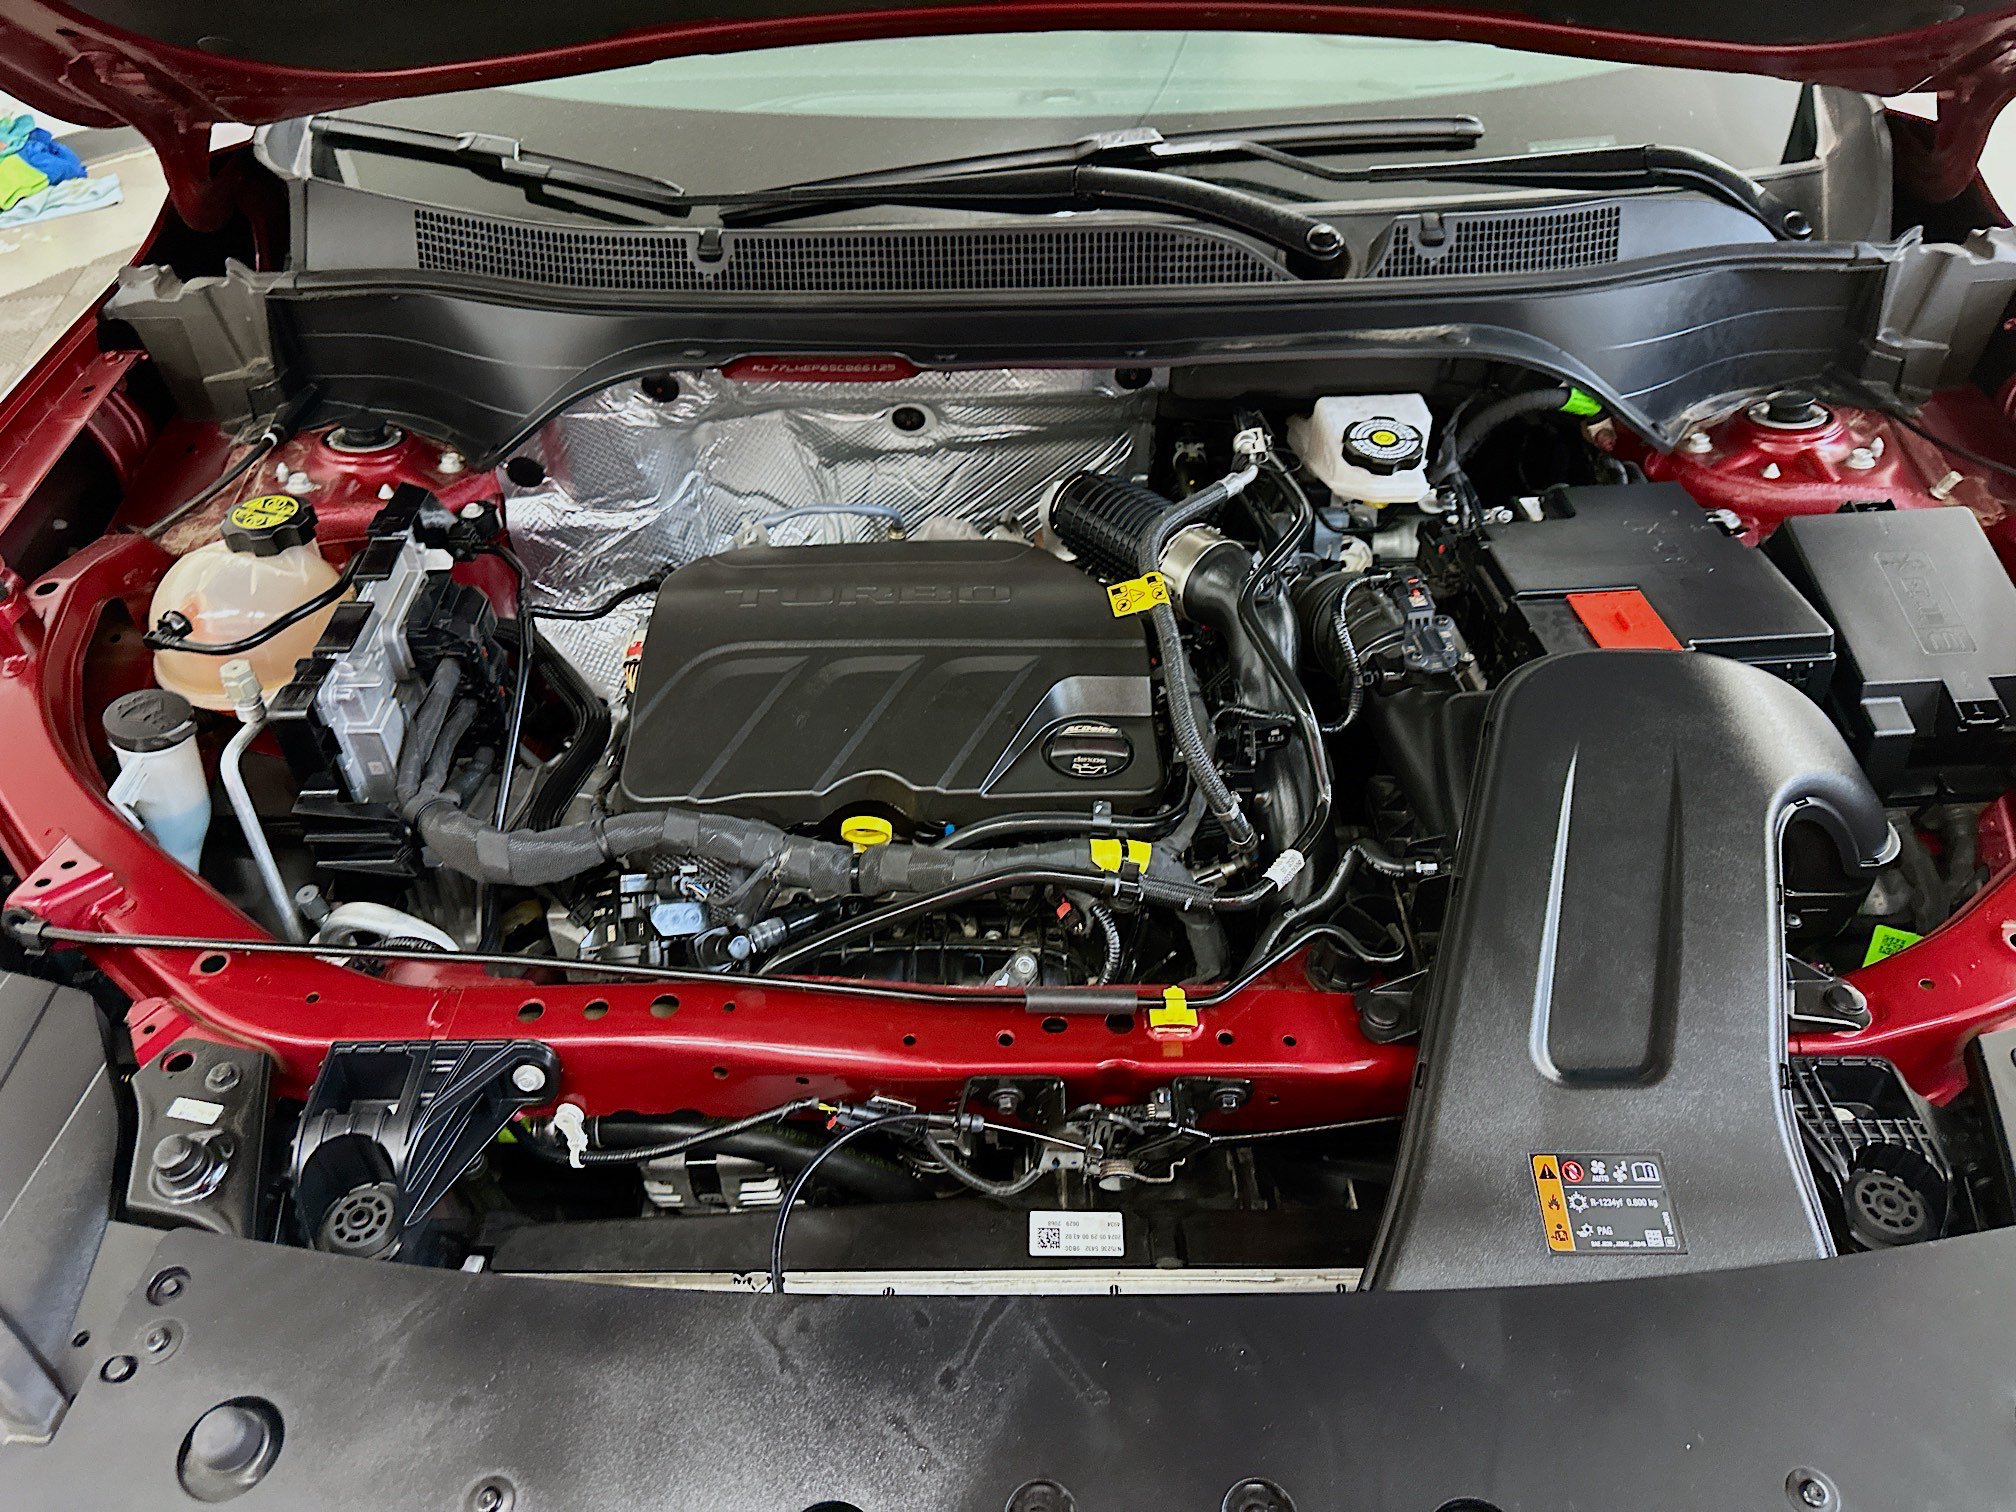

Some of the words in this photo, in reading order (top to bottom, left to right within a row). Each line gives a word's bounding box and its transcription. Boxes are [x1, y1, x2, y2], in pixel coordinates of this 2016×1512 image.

[723, 585, 1013, 609] TURBO
[1061, 725, 1119, 736] ACDelco
[1073, 755, 1107, 764] dexos
[1592, 1174, 1610, 1182] AUTO
[1590, 1198, 1624, 1208] R-1234yf
[1648, 1198, 1659, 1208] kg
[1597, 1226, 1614, 1236] PAG
